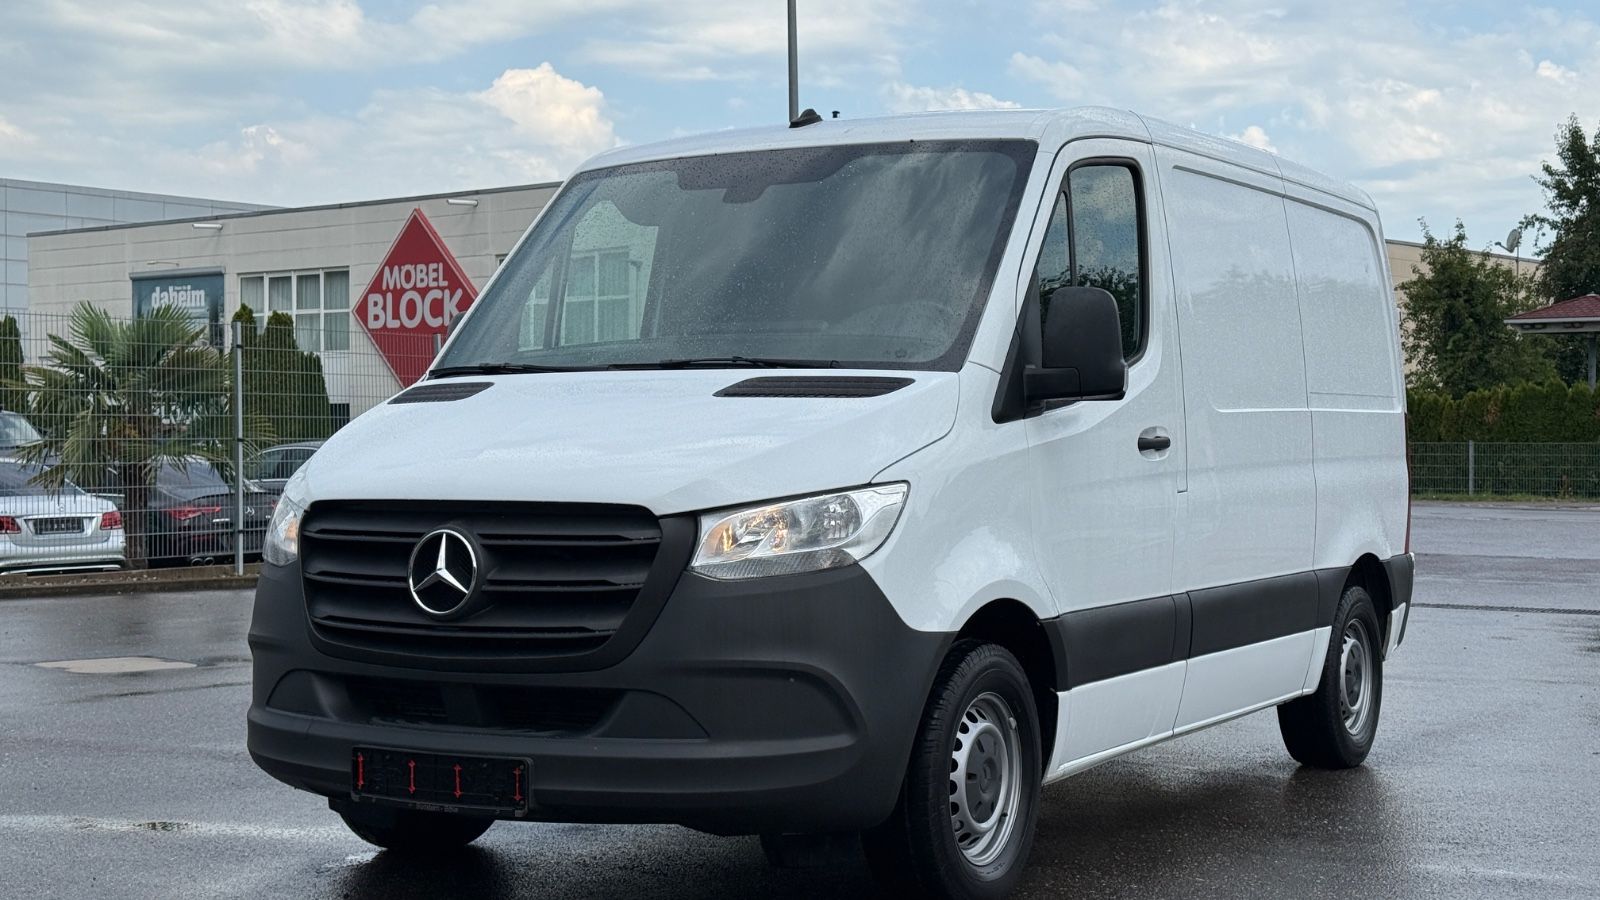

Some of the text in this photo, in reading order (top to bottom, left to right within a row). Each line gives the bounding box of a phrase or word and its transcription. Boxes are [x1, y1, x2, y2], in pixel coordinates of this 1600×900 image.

[382, 263, 448, 290] MÖBEL
[152, 285, 205, 308] daheim
[367, 288, 463, 329] BLOCK
